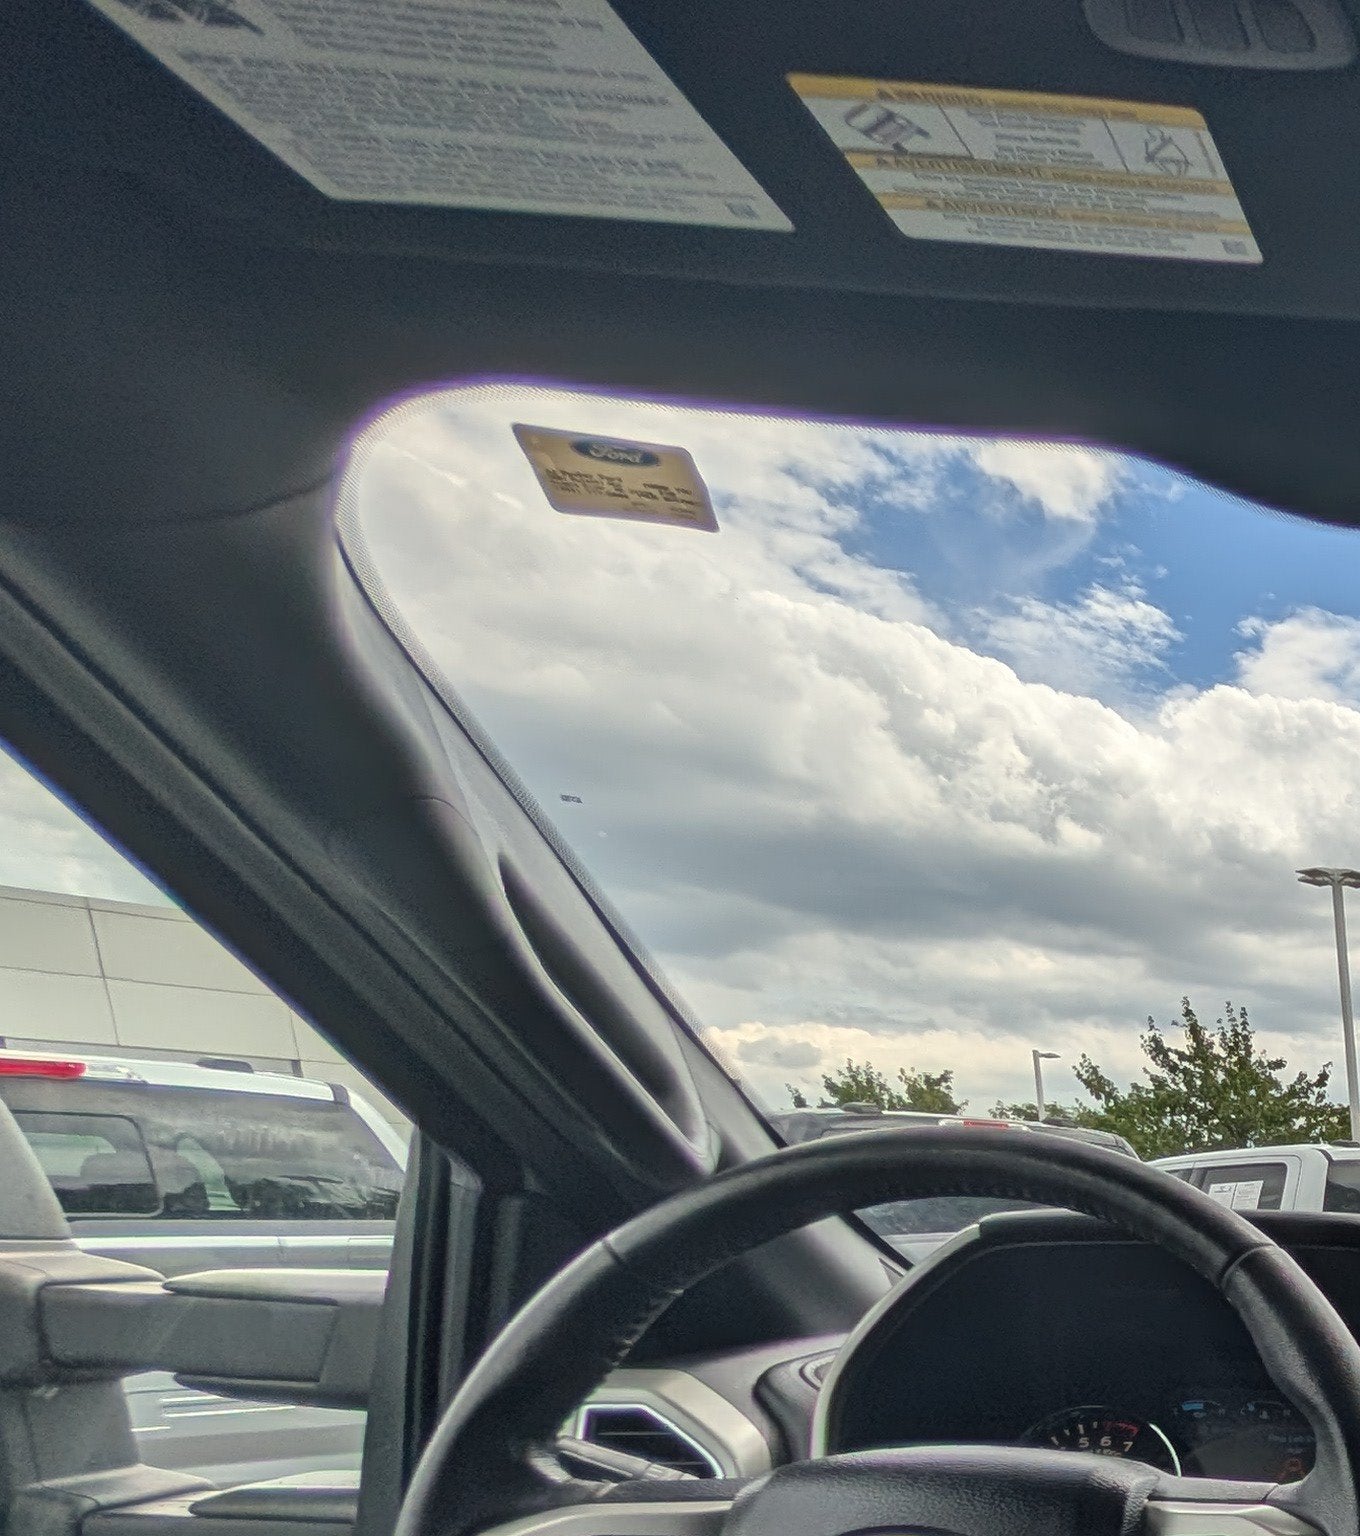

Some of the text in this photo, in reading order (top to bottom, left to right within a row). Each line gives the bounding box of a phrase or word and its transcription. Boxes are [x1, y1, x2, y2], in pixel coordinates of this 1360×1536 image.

[1079, 1437, 1090, 1448] 5
[1101, 1436, 1112, 1447] 6
[1123, 1441, 1133, 1452] 7
